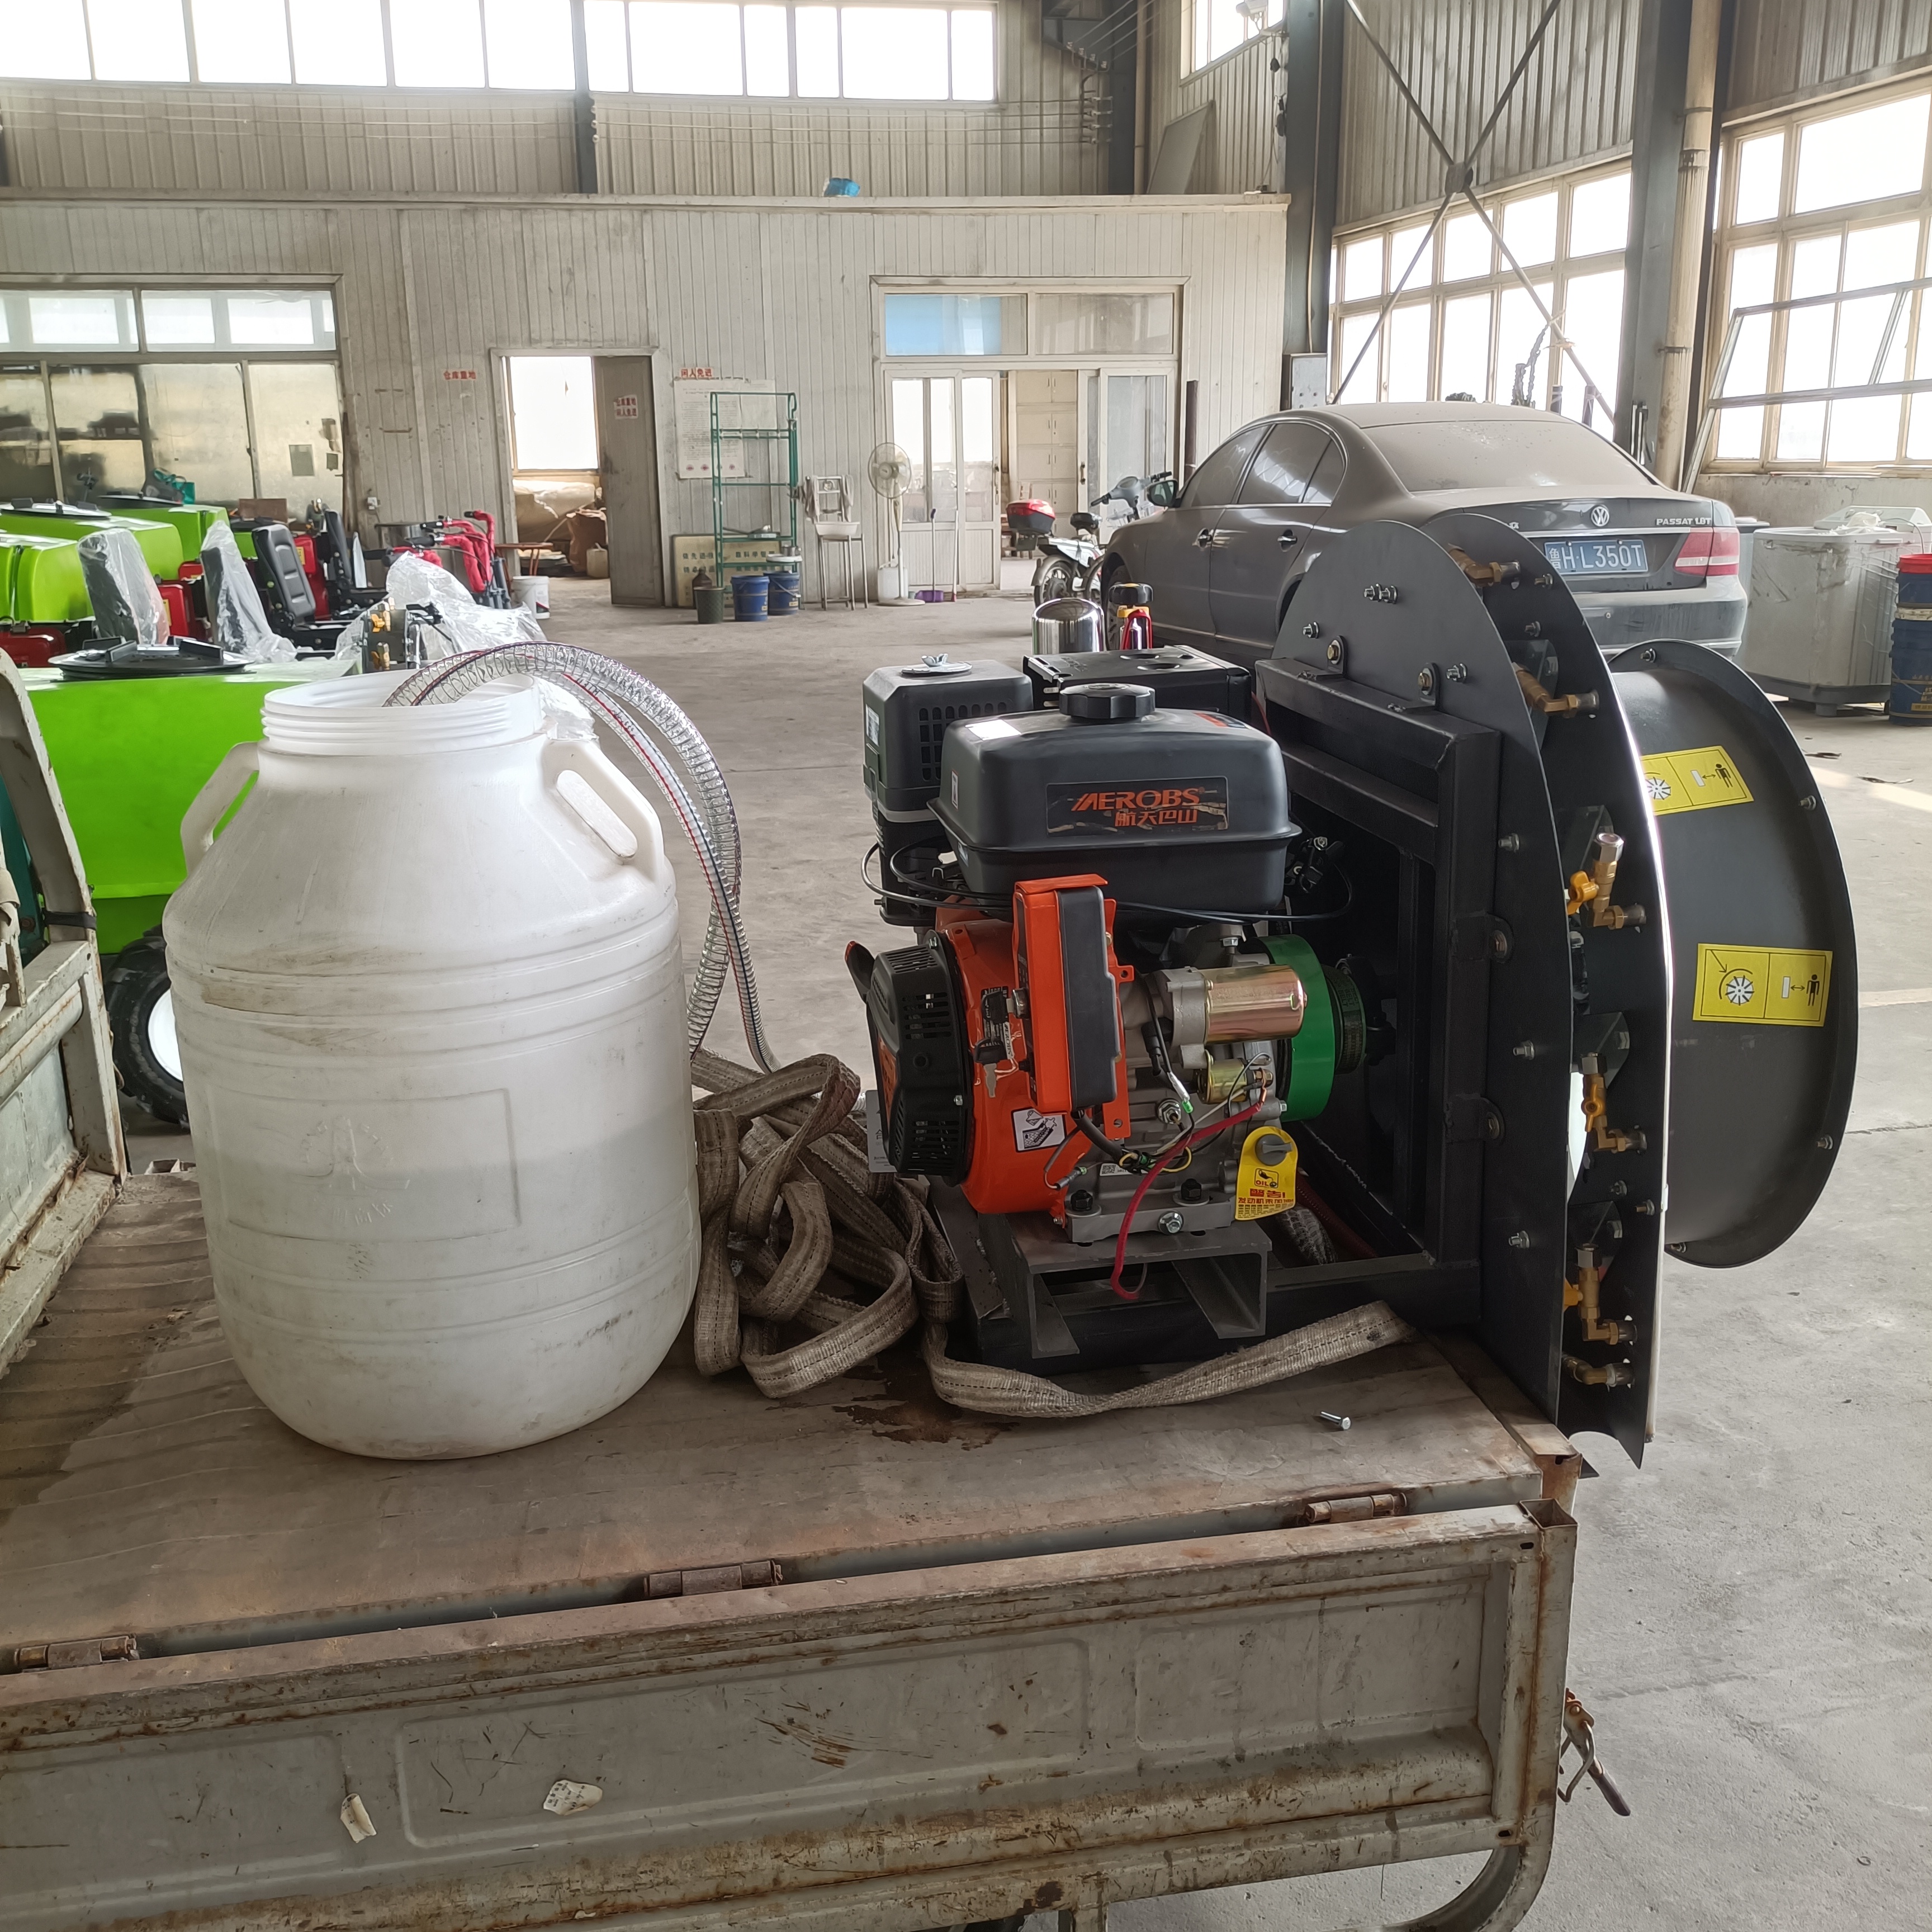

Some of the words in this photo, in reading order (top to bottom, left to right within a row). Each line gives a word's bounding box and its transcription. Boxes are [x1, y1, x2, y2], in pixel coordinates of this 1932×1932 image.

[443, 371, 476, 380] 仓库重地
[681, 368, 712, 378] 闲人免进
[1071, 788, 1200, 811] AEROBS
[1115, 810, 1197, 827] 航天巴山
